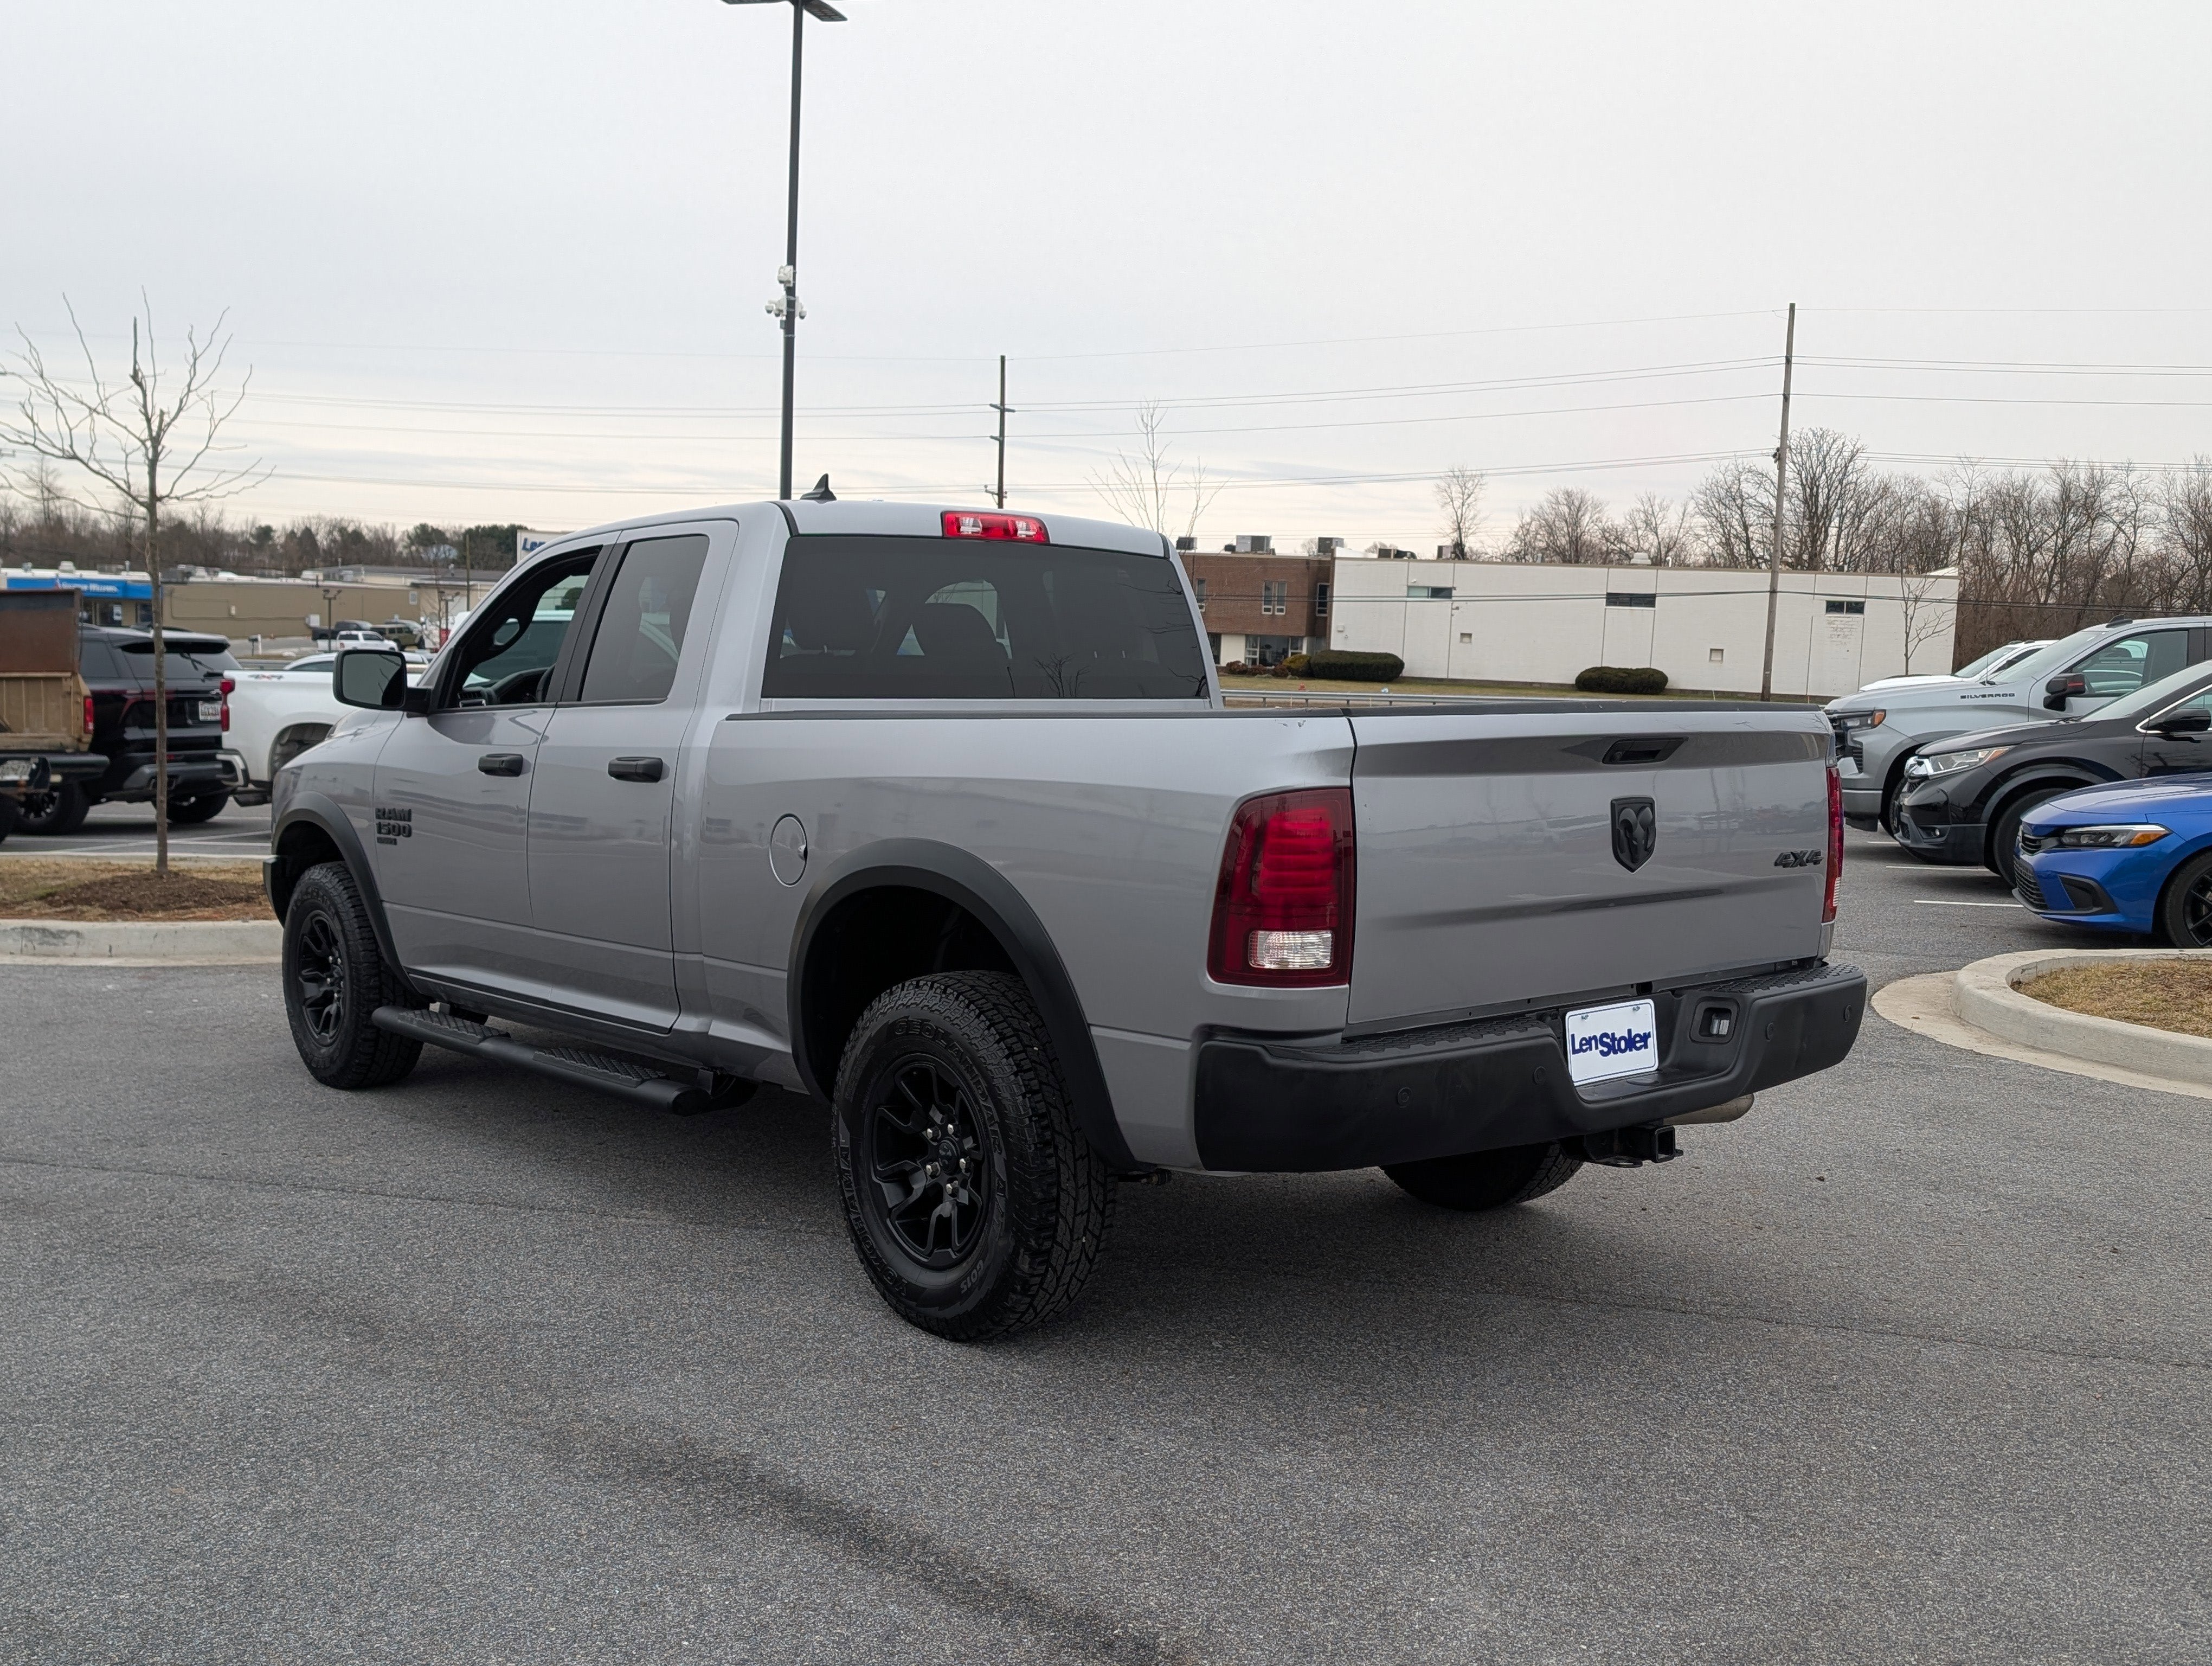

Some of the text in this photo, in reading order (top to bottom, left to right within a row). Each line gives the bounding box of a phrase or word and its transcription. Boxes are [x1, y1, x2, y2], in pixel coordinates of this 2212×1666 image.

[375, 808, 411, 822] RAM
[376, 822, 412, 838] 1500
[894, 1020, 1003, 1155] GEOLANDAR
